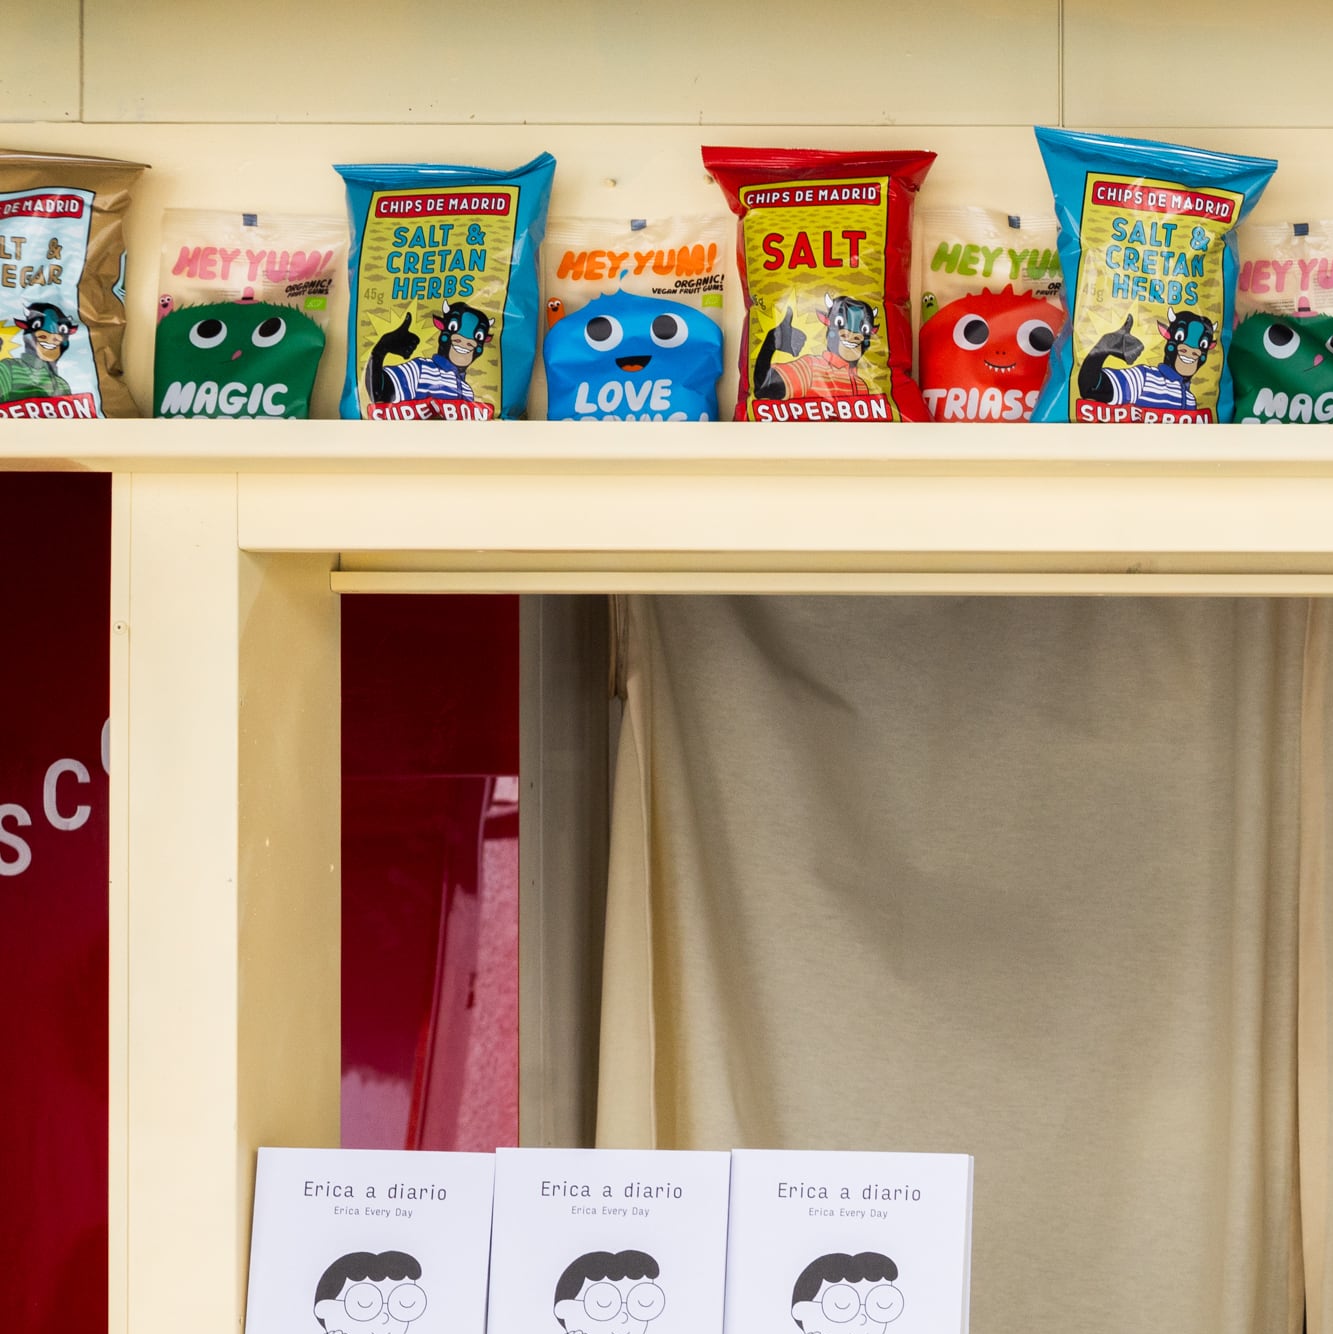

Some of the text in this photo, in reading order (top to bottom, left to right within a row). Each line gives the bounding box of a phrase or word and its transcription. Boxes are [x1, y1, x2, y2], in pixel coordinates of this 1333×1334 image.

[381, 198, 505, 212] CHIPS DE MADRID
[392, 223, 486, 248] SALT &
[386, 249, 486, 274] CRETAN
[557, 243, 717, 281] HEY YUM!
[762, 230, 867, 271] SALT
[172, 247, 335, 284] HEY YUM!
[392, 273, 475, 300] HERBS
[161, 381, 288, 415] MAGIC
[575, 379, 672, 414] LOVE
[304, 1180, 447, 1201] Erica a diario
[334, 1206, 412, 1218] Erica Every Day
